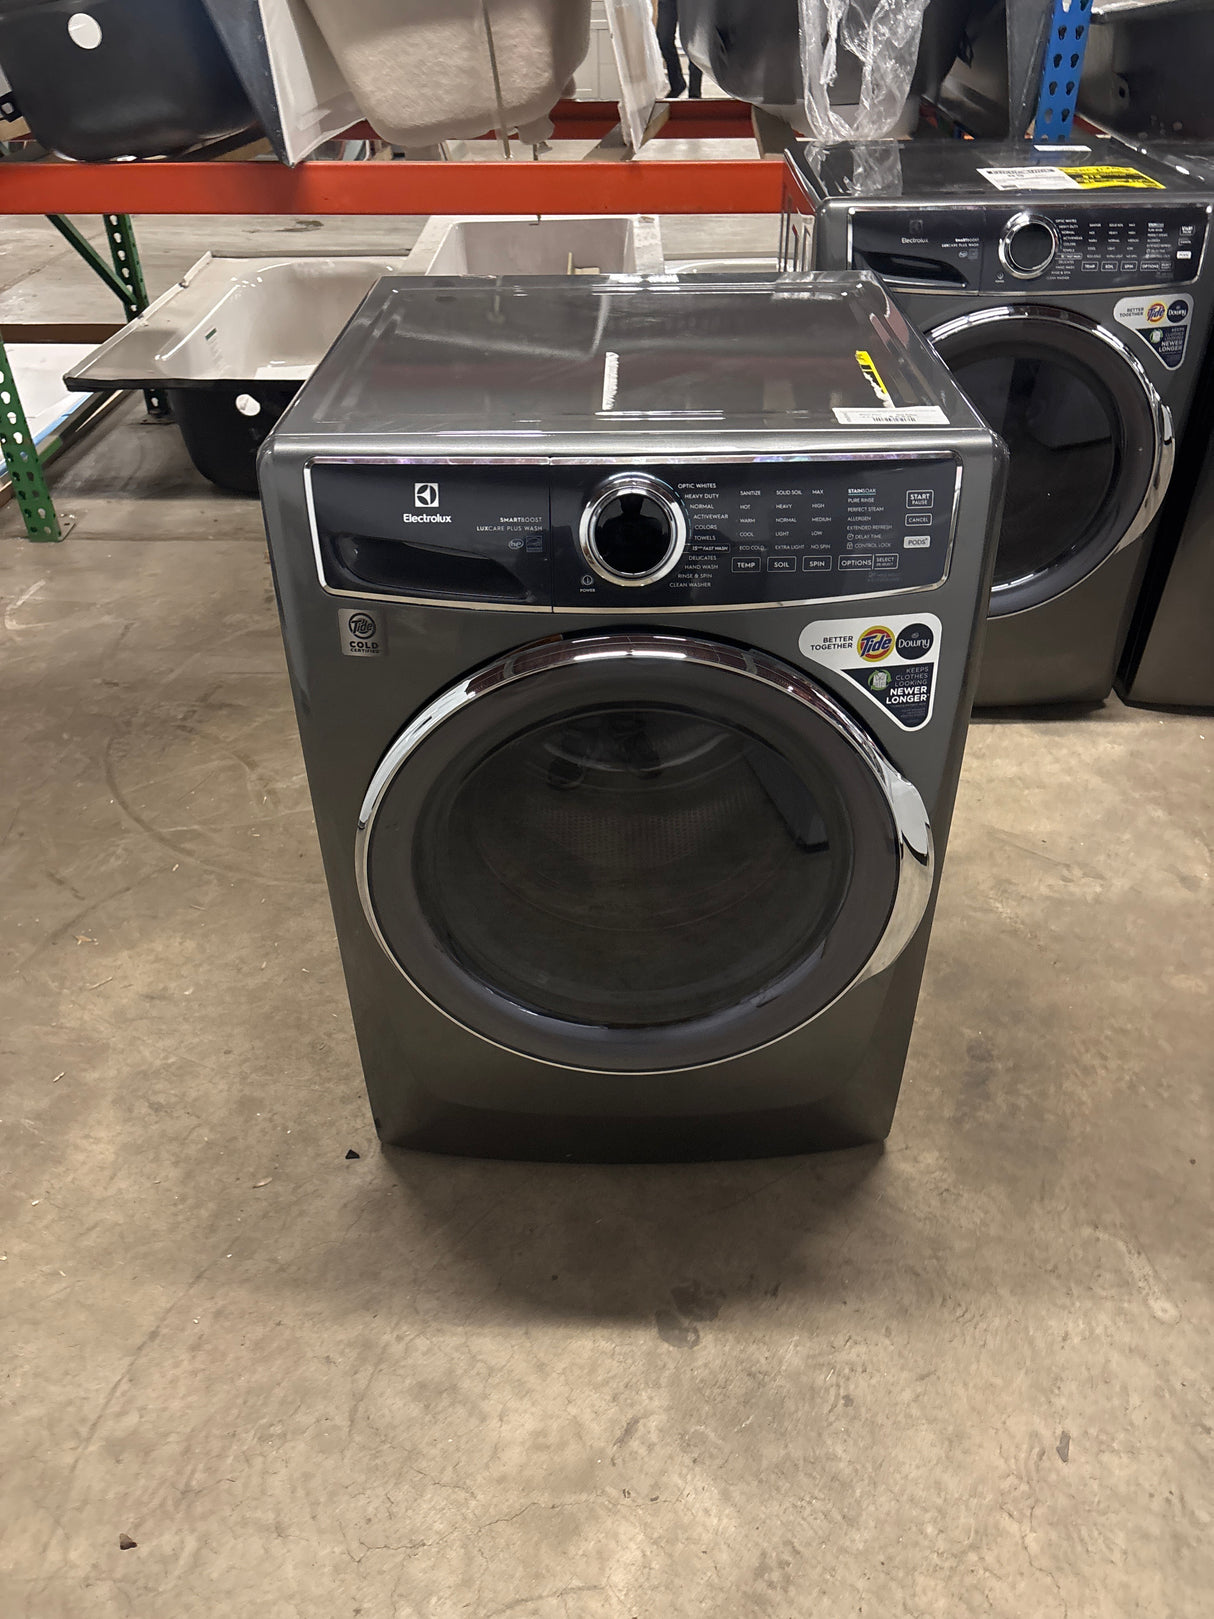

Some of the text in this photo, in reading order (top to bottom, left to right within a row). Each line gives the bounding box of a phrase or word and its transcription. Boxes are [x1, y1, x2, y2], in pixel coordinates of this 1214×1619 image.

[1147, 307, 1166, 322] Tide
[403, 513, 452, 524] Electrolux
[908, 538, 926, 546] PODS
[351, 618, 373, 634] Tide
[823, 635, 854, 644] BETTER
[898, 637, 930, 650] Downy
[349, 640, 379, 649] COLD
[810, 642, 853, 651] TOGETHER
[859, 634, 892, 658] Tide
[906, 666, 929, 674] KEEPS
[895, 673, 928, 681] CLOTHES
[894, 679, 928, 687] LOOKING
[890, 686, 928, 696] NEWER
[886, 694, 928, 705] LONGER
